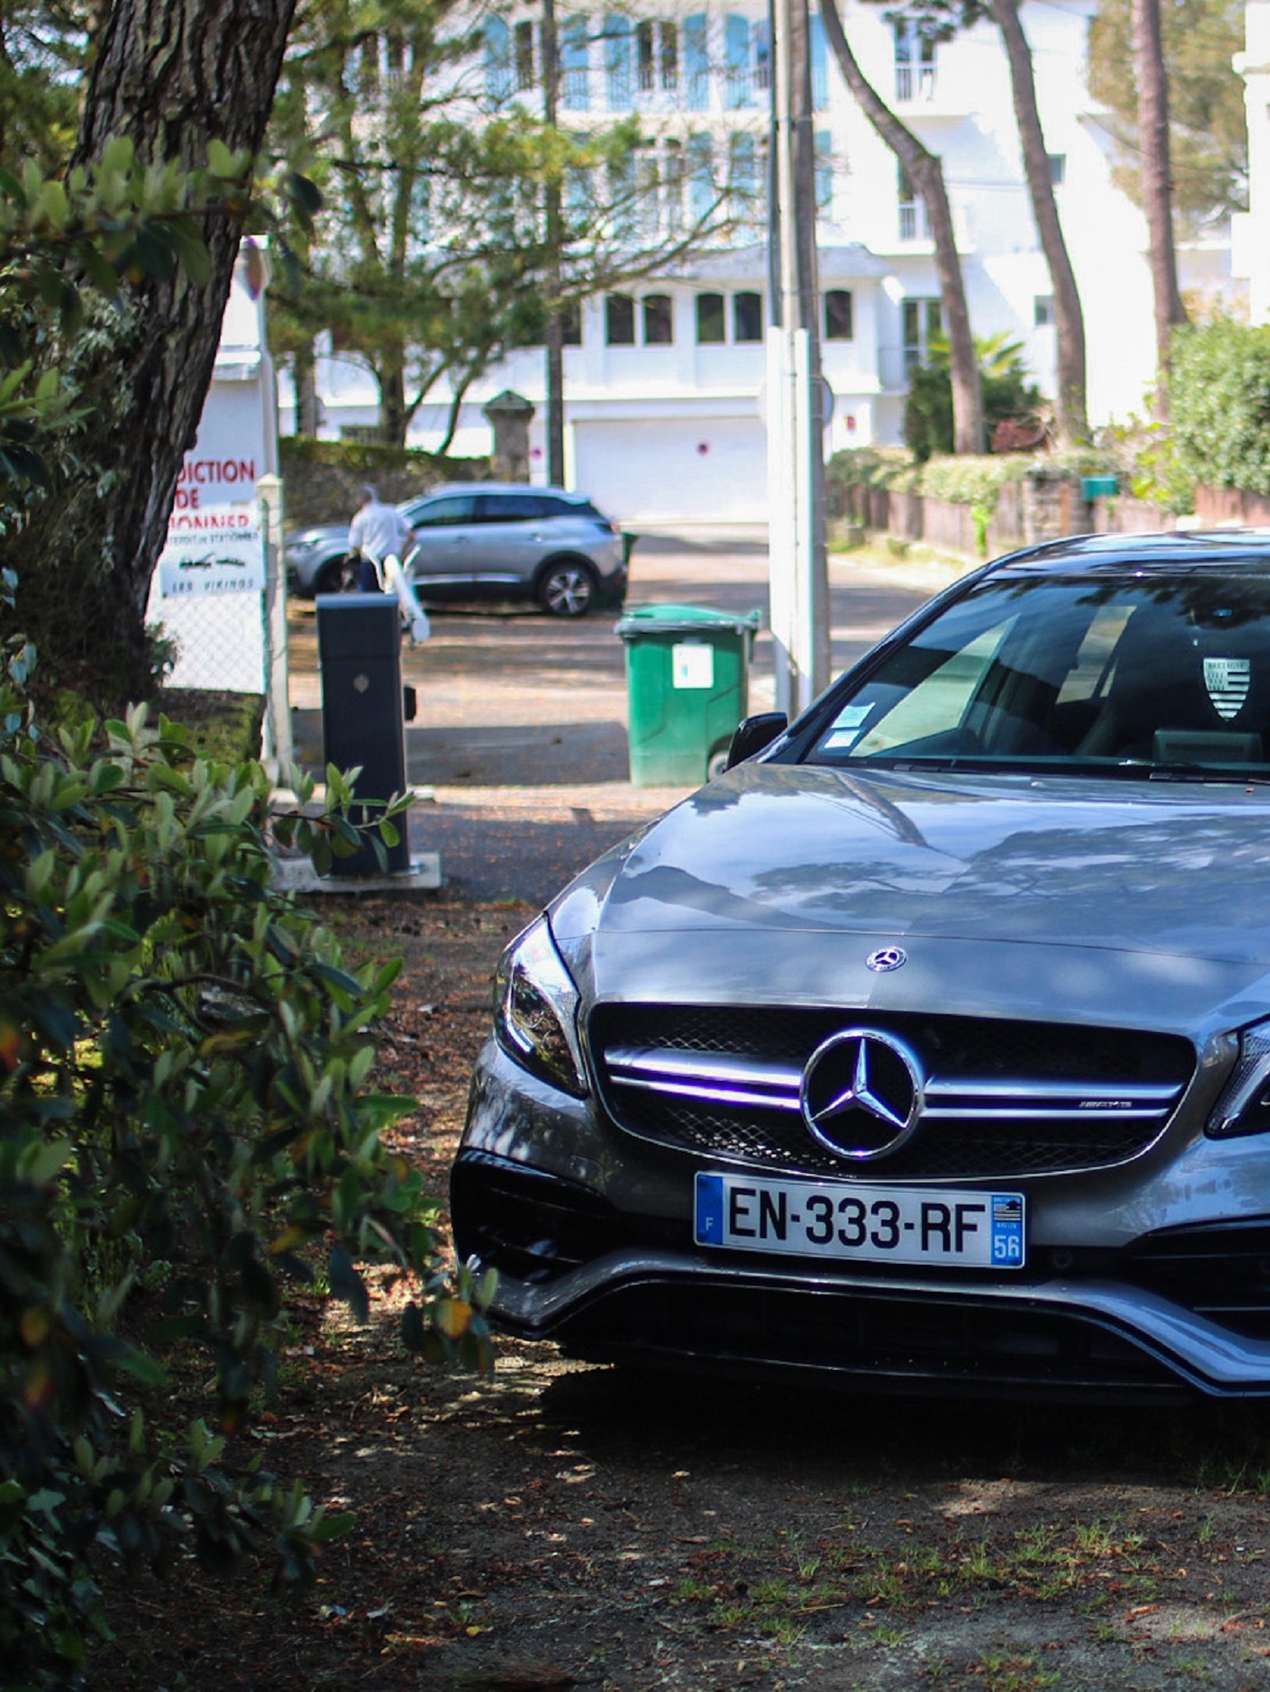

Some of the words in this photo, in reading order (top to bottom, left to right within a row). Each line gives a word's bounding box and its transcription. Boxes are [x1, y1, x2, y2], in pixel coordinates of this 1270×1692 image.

[176, 488, 199, 509] DE
[204, 578, 254, 591] VIKINGS
[705, 1217, 714, 1231] F
[729, 1186, 986, 1253] EN-333-RF
[994, 1235, 1020, 1259] 56
